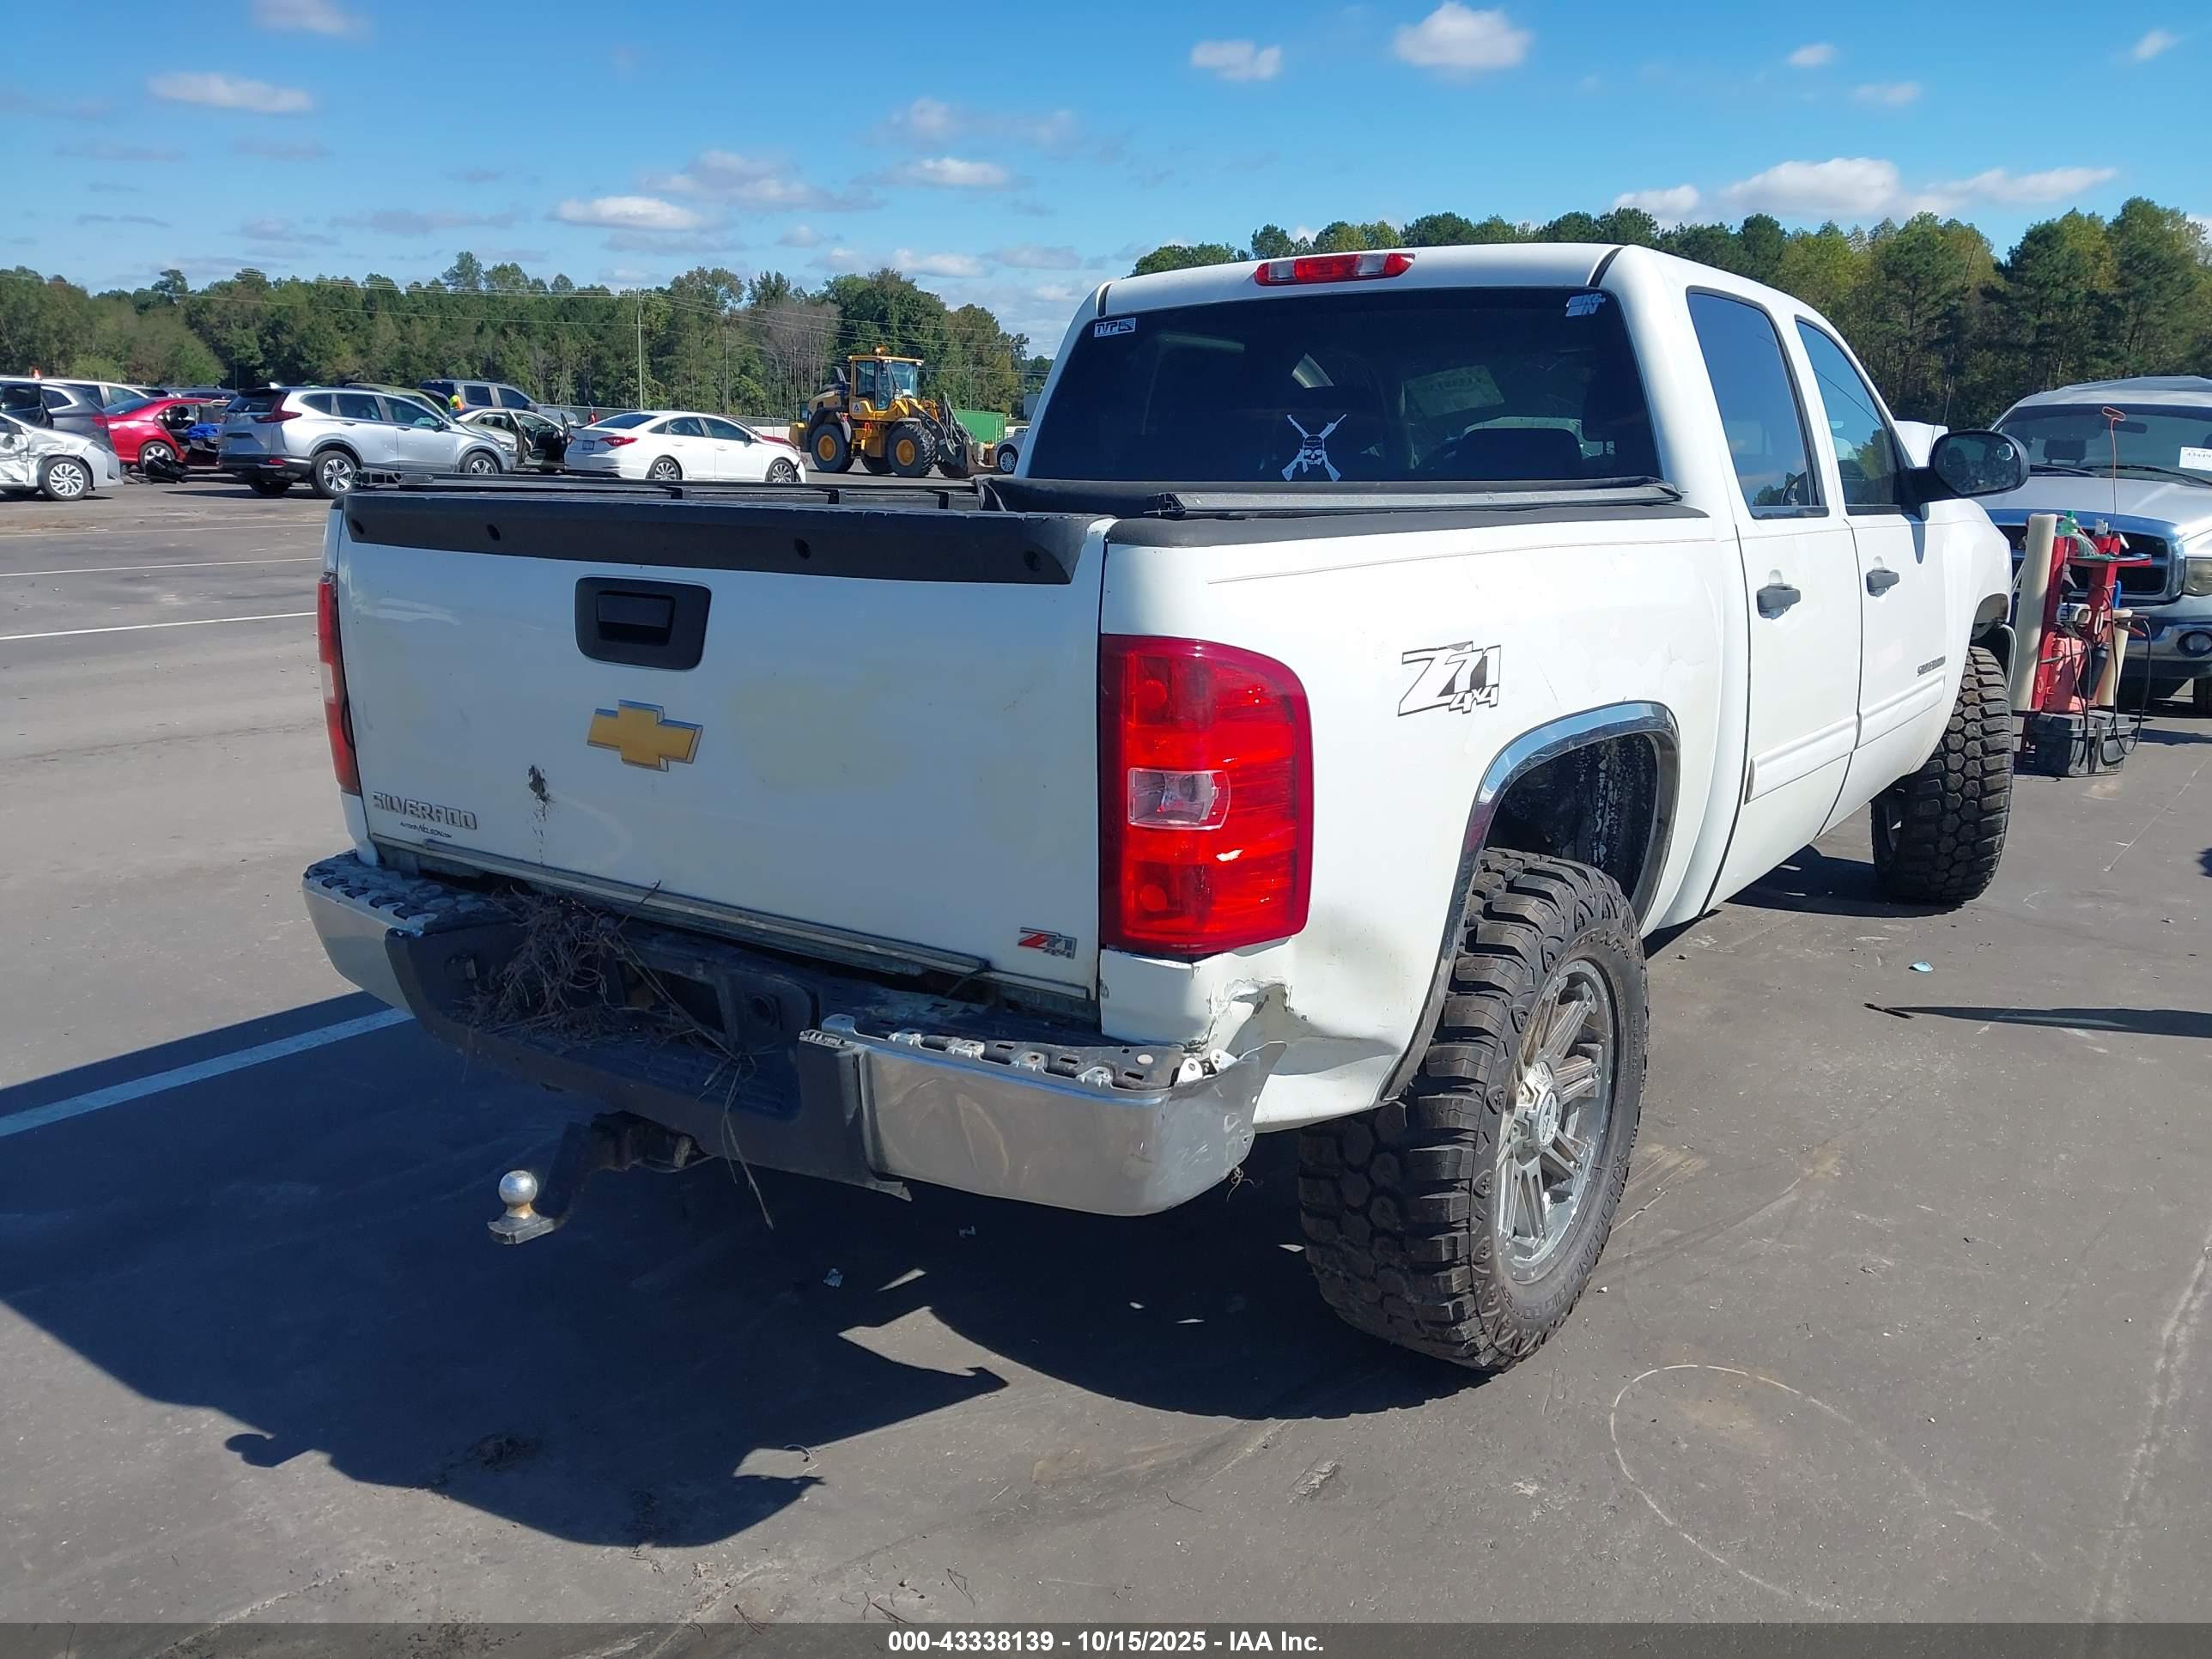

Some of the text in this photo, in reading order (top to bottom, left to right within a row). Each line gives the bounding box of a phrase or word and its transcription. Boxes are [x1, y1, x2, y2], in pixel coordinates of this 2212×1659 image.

[1398, 641, 1501, 716] Z71
[371, 792, 478, 830] SILVERADO
[1017, 927, 1078, 951] Z71
